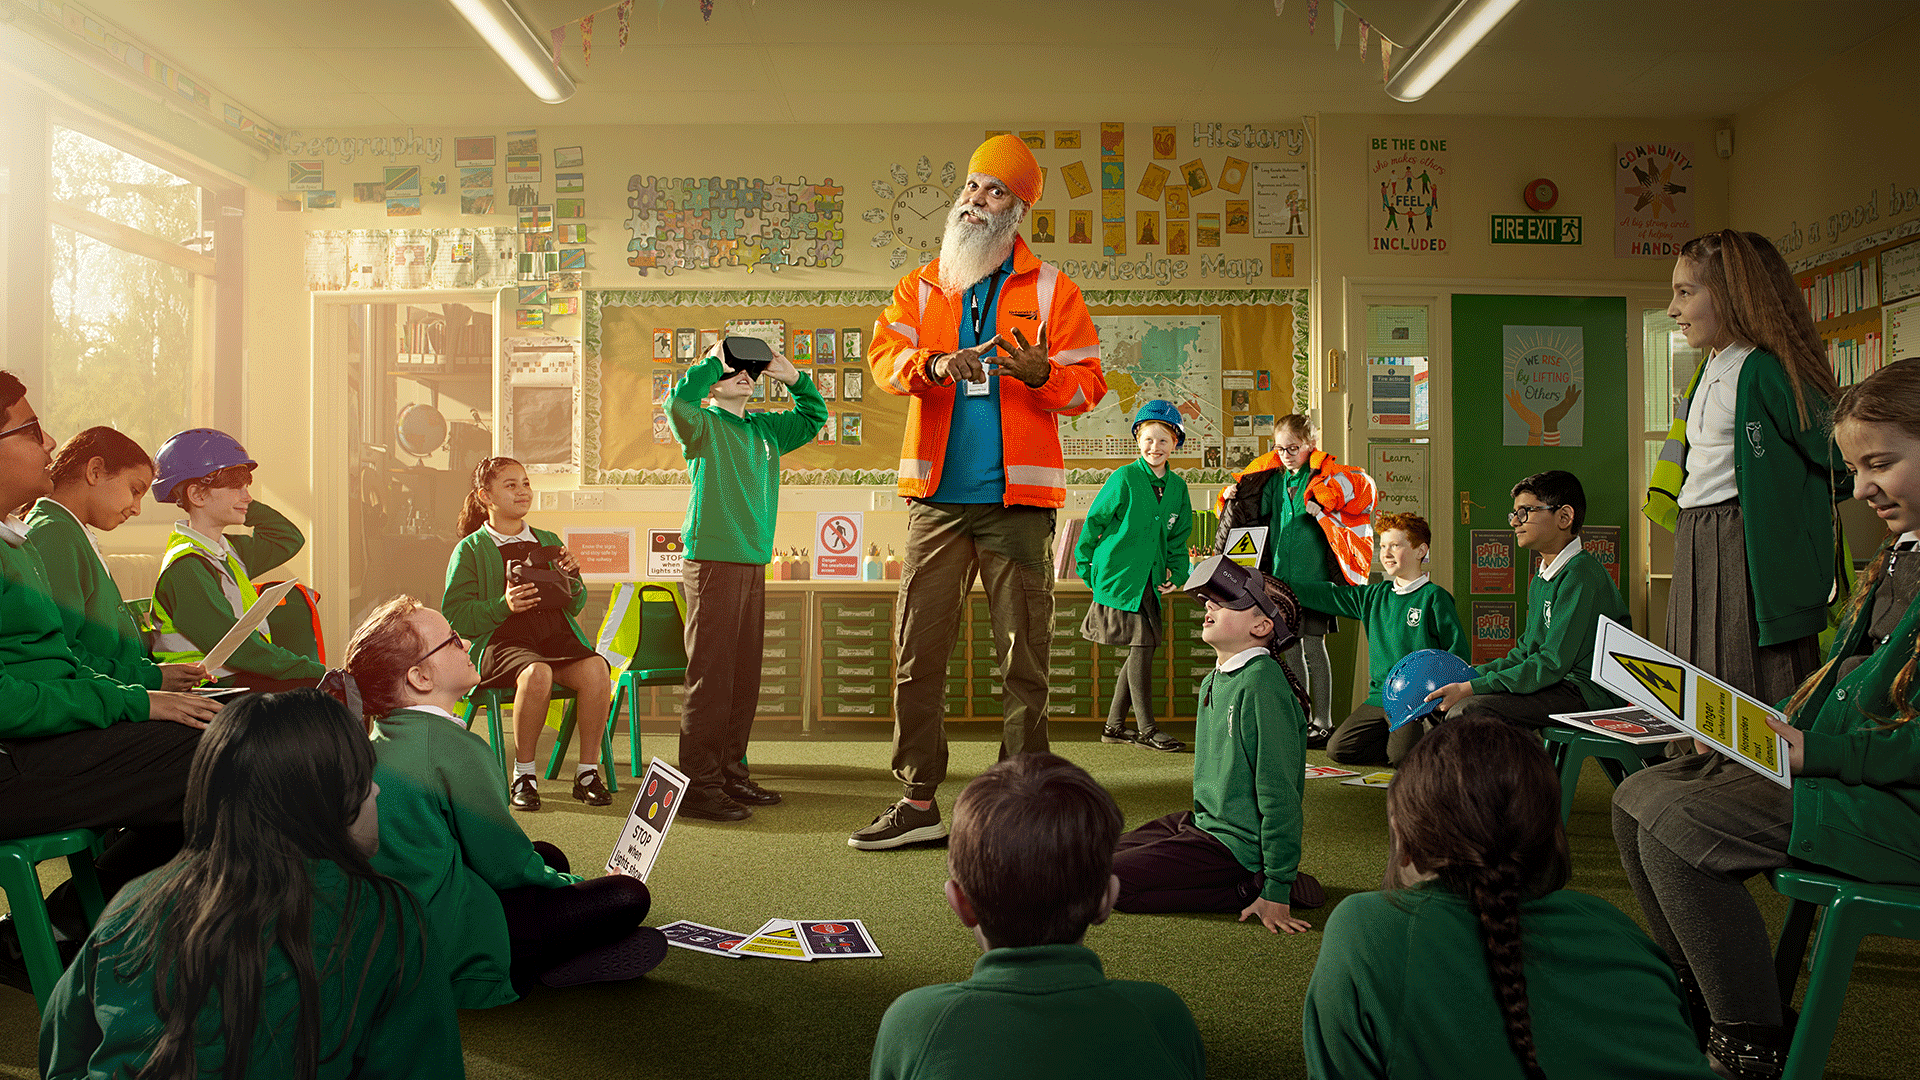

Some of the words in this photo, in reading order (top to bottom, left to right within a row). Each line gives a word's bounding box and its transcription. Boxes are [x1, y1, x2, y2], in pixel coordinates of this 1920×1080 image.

[282, 128, 442, 164] Geography
[1193, 122, 1303, 156] History
[1372, 138, 1387, 150] BE
[1392, 139, 1415, 150] THE
[1420, 140, 1446, 151] ONE
[1372, 160, 1388, 173] who
[1391, 152, 1416, 165] makes
[1420, 157, 1446, 175] others
[1620, 144, 1693, 171] COMMUNITY
[1396, 196, 1425, 206] FEEL
[1620, 217, 1630, 226] A
[1632, 217, 1643, 228] big
[1646, 219, 1668, 229] strong
[1670, 220, 1690, 228] circle
[1826, 189, 1879, 244] good
[1495, 218, 1524, 239] FIRE
[1528, 219, 1557, 240] EXIT
[1648, 230, 1674, 240] helping
[1374, 238, 1446, 251] INCLUDED
[1631, 242, 1681, 255] HANDS
[1201, 253, 1263, 285] Map
[1524, 355, 1539, 366] WE
[1542, 355, 1562, 367] RISE
[1516, 369, 1529, 385] by
[1533, 372, 1570, 383] LIFTING
[1525, 385, 1560, 401] Others
[1382, 451, 1414, 463] Learn,
[1386, 471, 1413, 483] Know,
[1378, 491, 1418, 505] Progress,
[1477, 542, 1509, 556] BATTLE
[1584, 541, 1614, 552] BATTLE
[1478, 556, 1509, 568] BANDS
[1478, 614, 1509, 628] BATTLE
[1479, 628, 1510, 639] BANDS
[1702, 702, 1716, 732] Danger
[1740, 716, 1750, 752] Horseriders
[1753, 742, 1761, 759] must
[1764, 735, 1774, 766] dismount
[632, 825, 652, 846] STOP
[628, 844, 642, 861] when
[614, 850, 629, 870] lights
[628, 864, 643, 879] show
